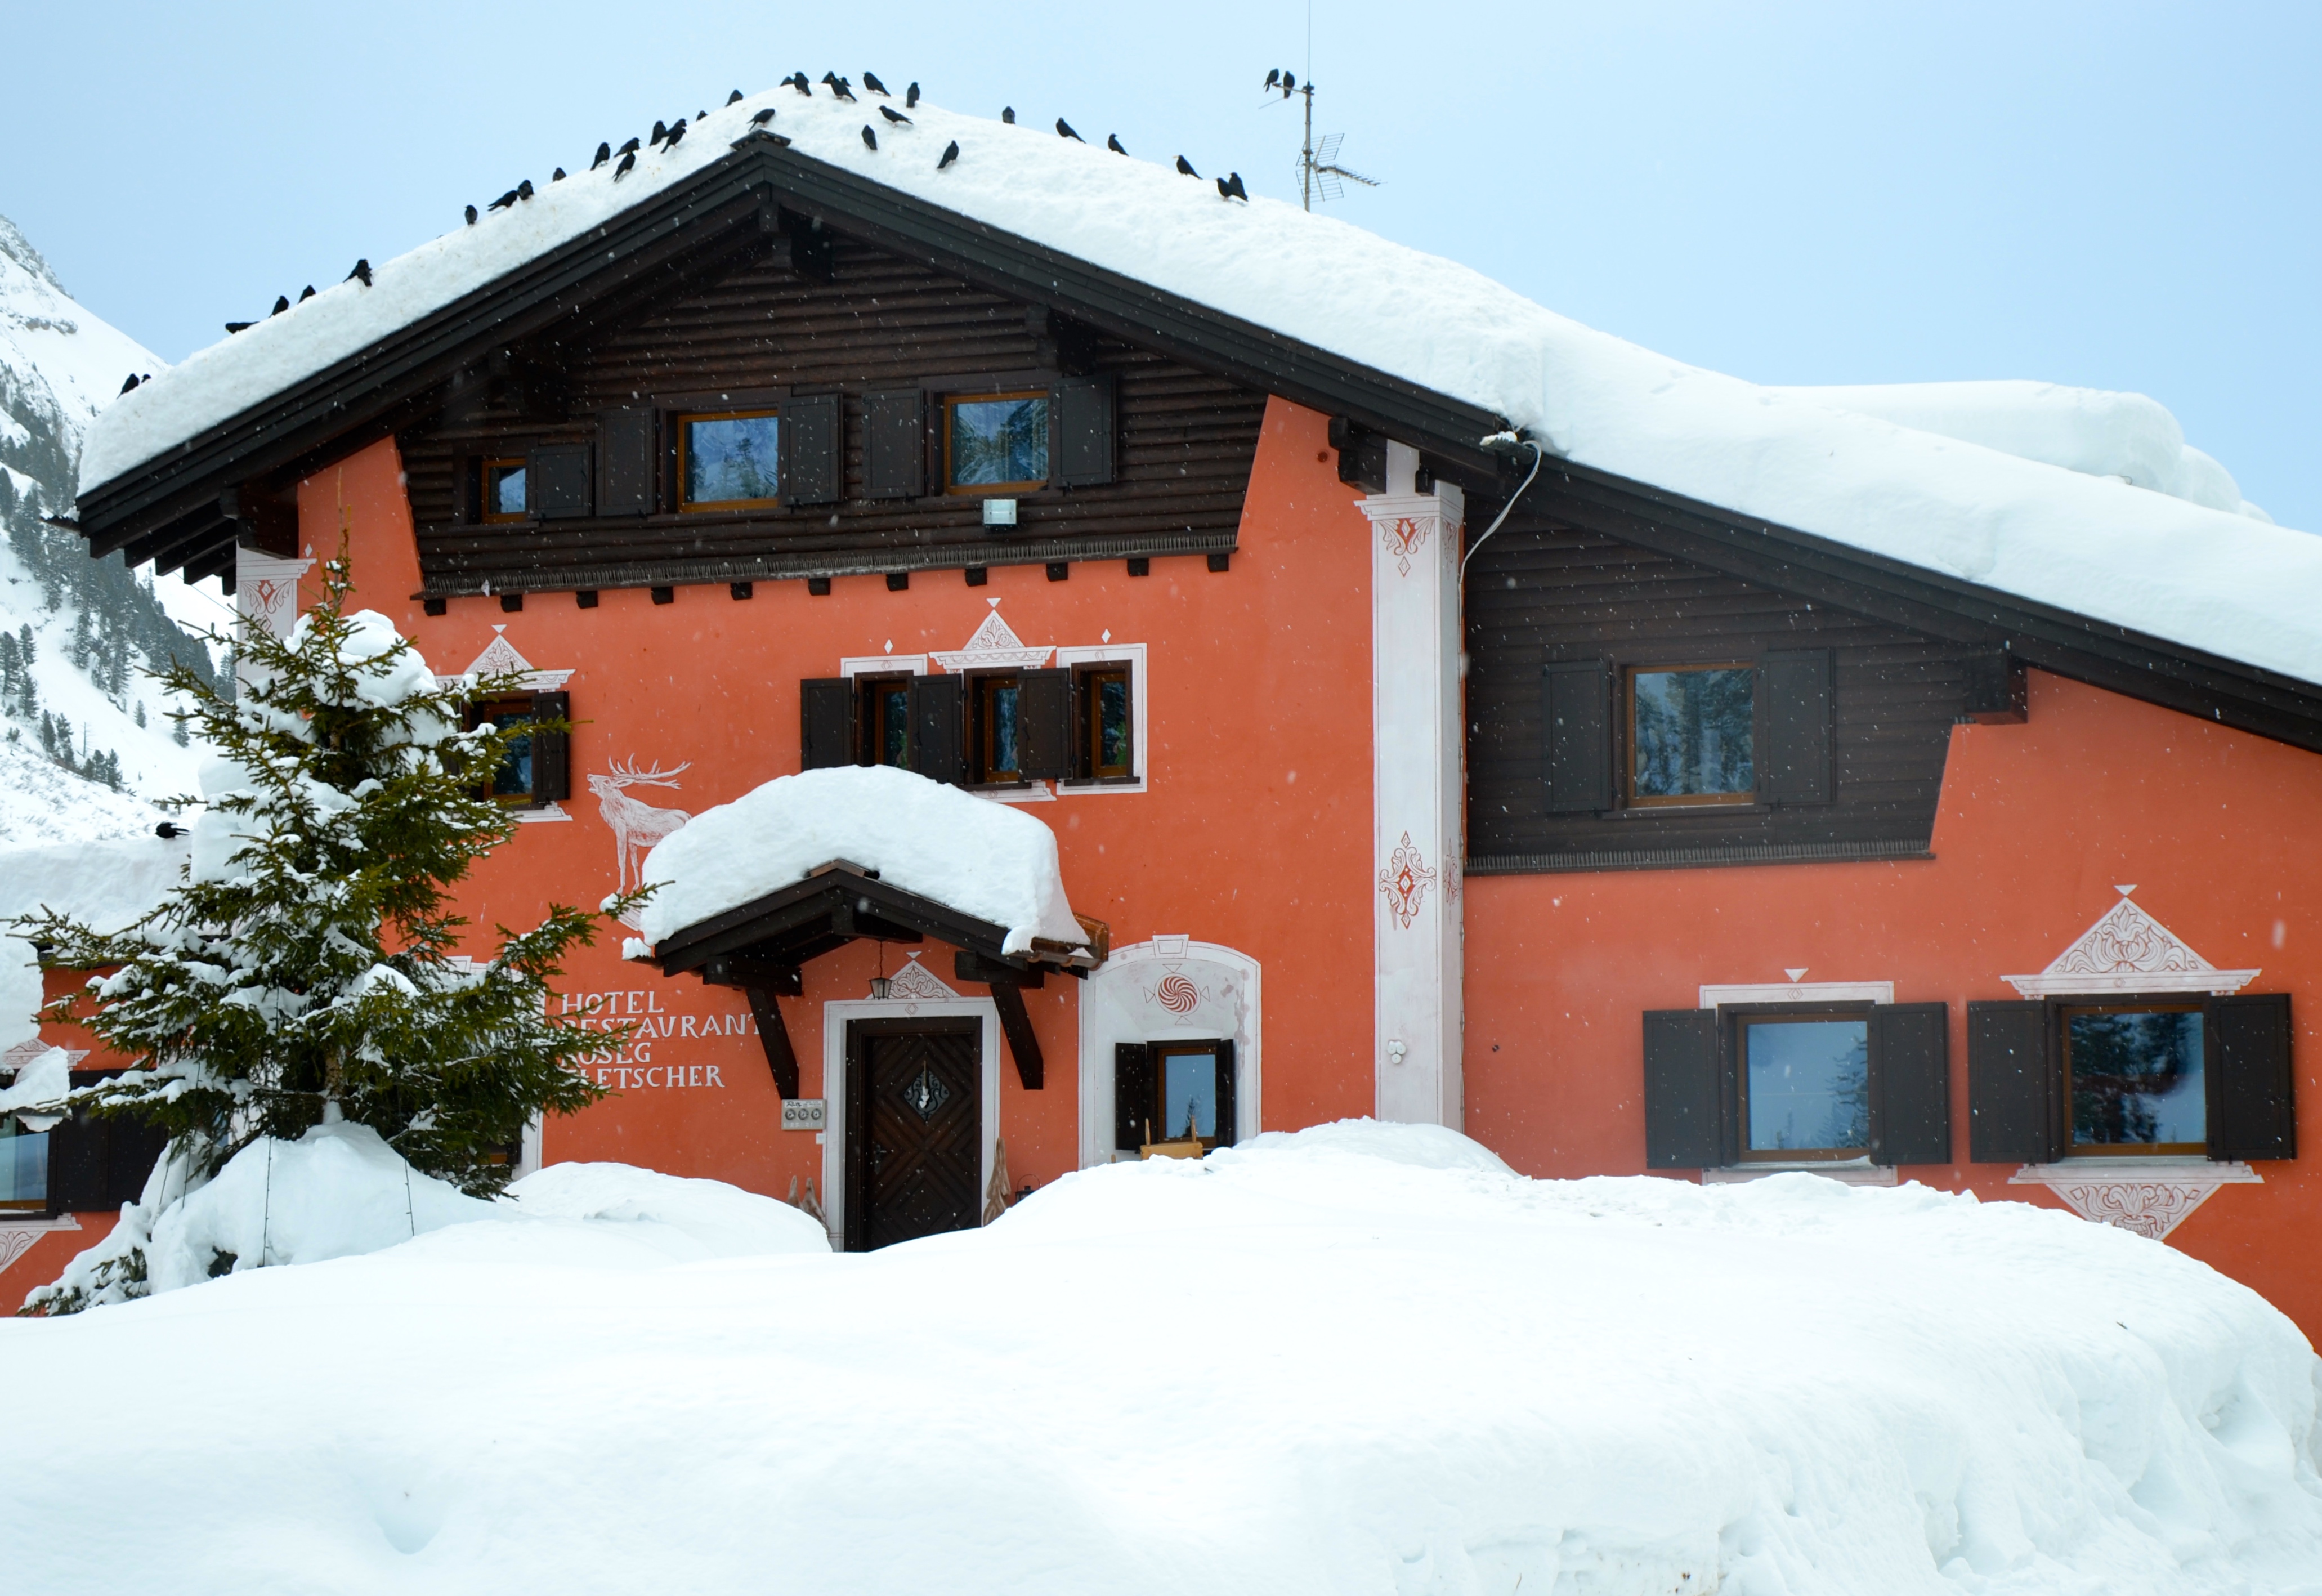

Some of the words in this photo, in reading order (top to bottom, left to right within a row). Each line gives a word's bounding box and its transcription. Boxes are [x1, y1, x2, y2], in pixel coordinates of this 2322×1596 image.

[561, 990, 665, 1015] HOTEL
[562, 1013, 759, 1040] ESTAURAN
[562, 1065, 726, 1089] ETSCHER
